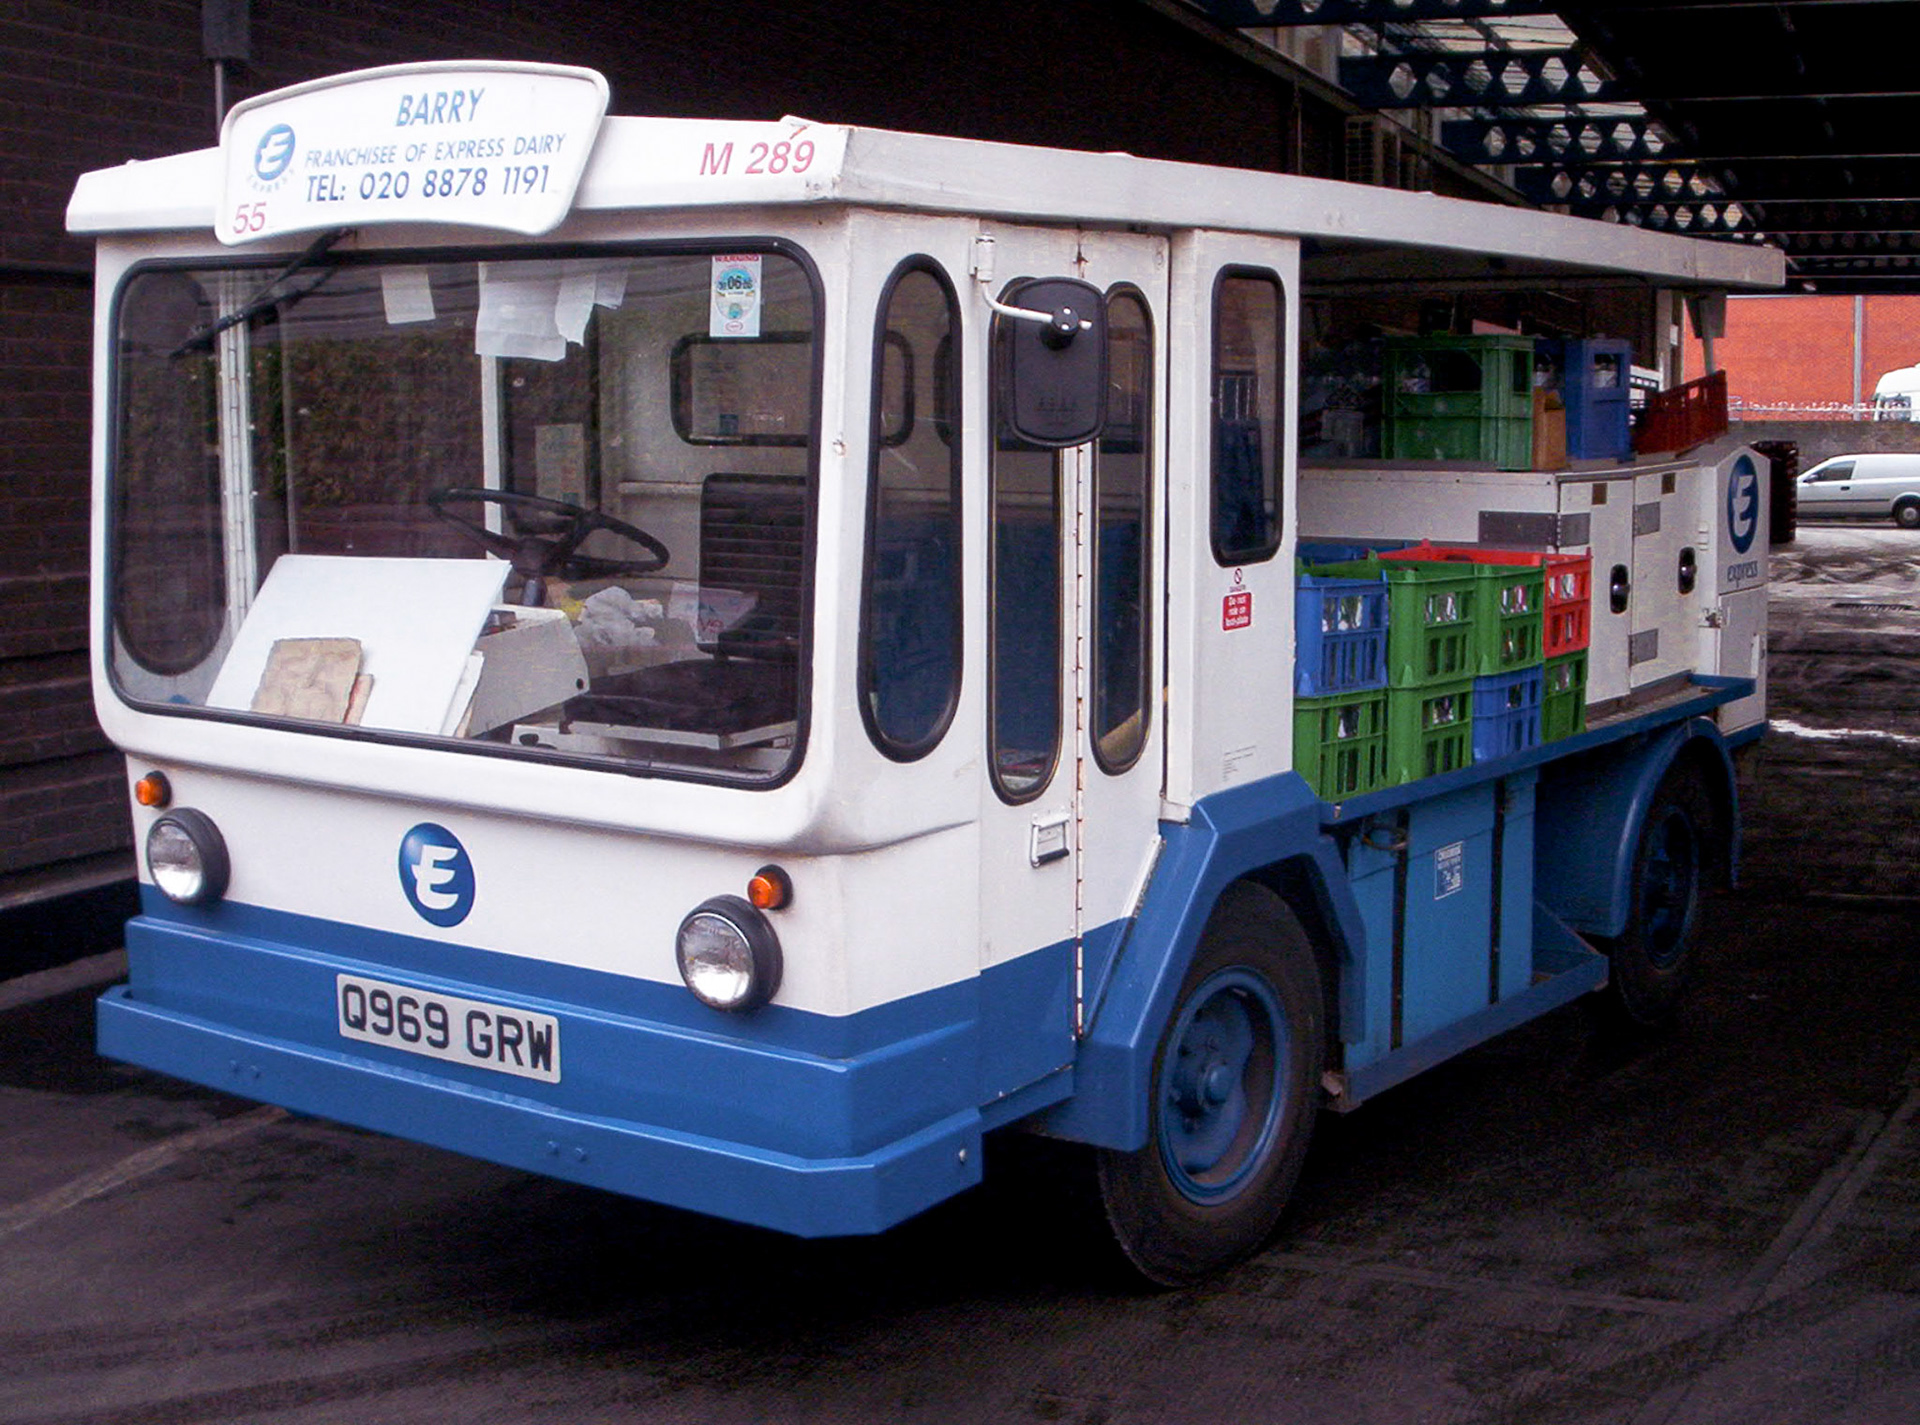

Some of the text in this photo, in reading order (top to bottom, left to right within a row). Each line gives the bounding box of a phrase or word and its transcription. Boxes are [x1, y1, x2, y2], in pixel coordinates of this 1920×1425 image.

[396, 87, 485, 126] BARRY
[305, 133, 567, 168] FRANCHISEE OF EXPRESS DAIRY
[699, 140, 815, 175] M 289
[306, 165, 549, 202] TEL: 020 8878 1191
[233, 203, 267, 234] 55
[727, 275, 742, 291] 06
[342, 984, 552, 1072] Q969 GRW
